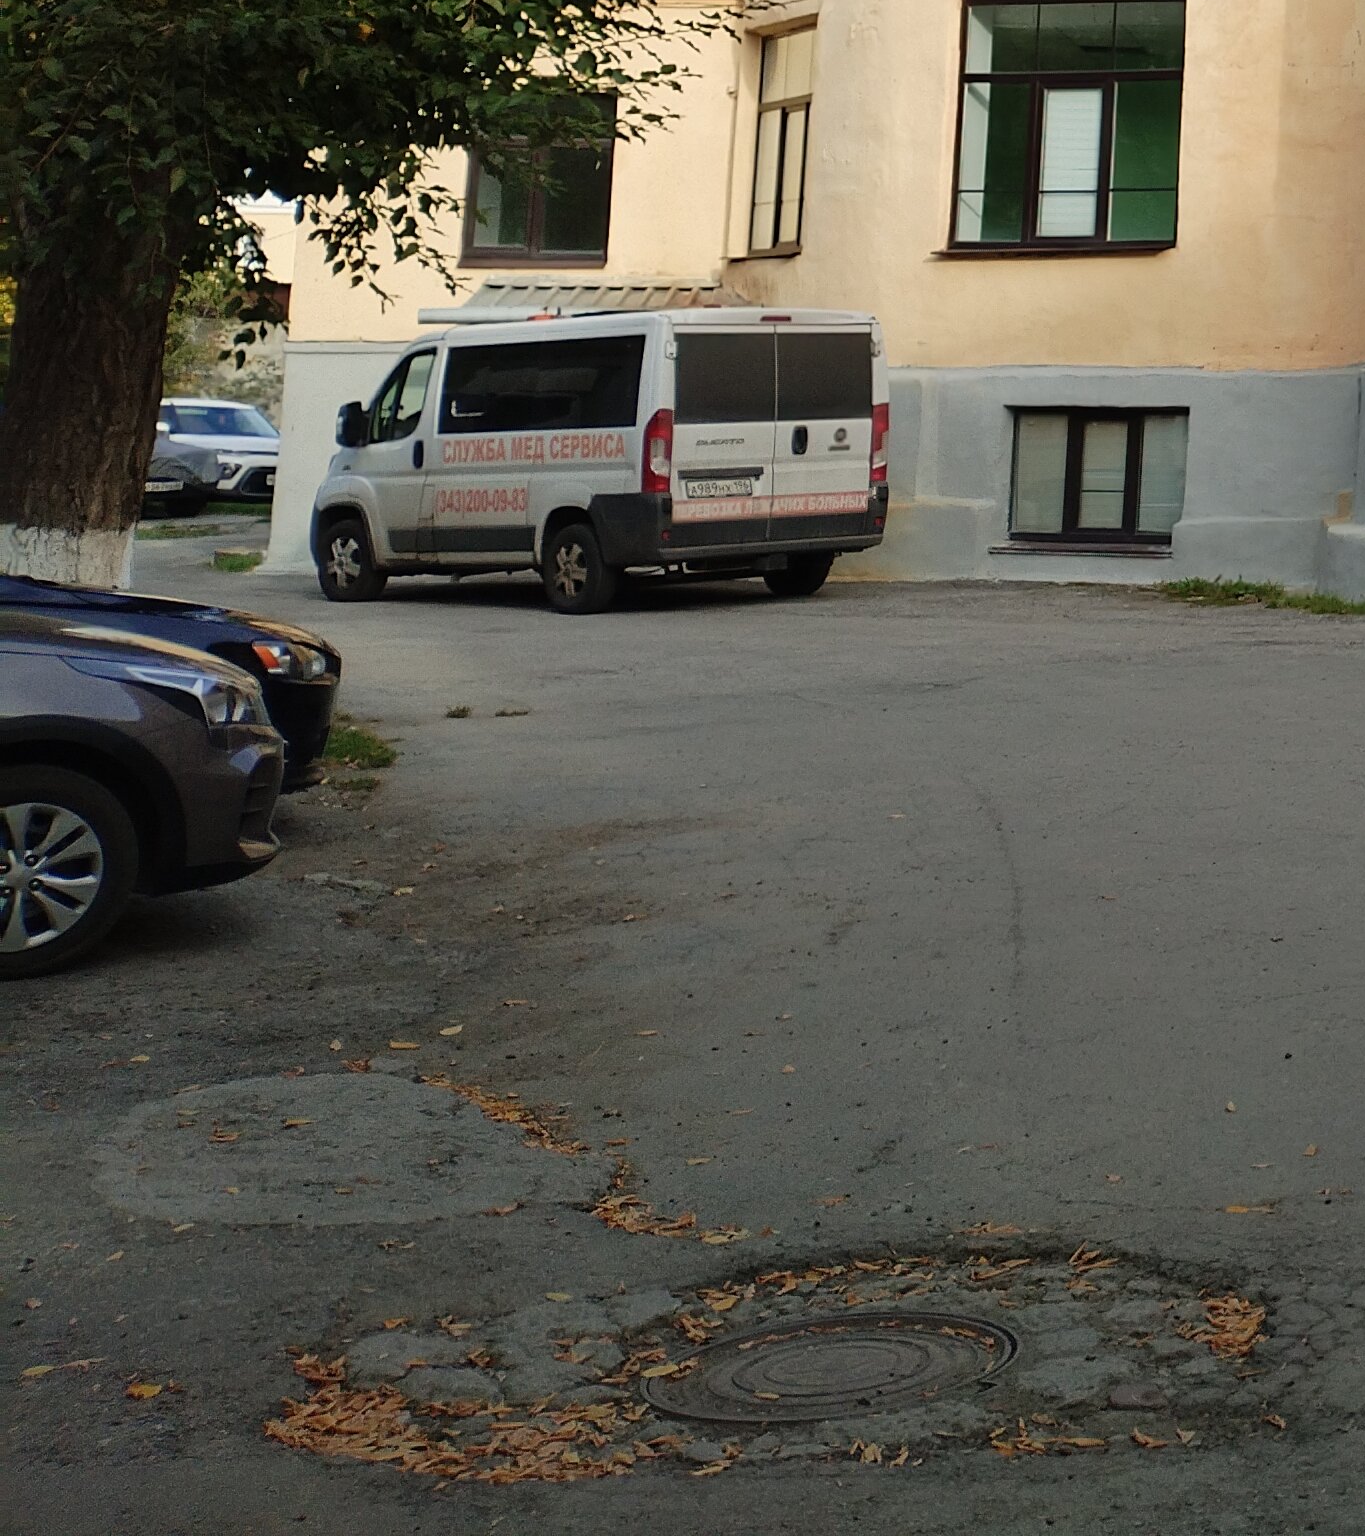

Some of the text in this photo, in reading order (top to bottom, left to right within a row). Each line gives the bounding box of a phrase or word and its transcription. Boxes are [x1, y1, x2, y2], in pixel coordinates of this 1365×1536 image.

[442, 433, 626, 464] СЛУЖБА МЕД СЕРВИСА
